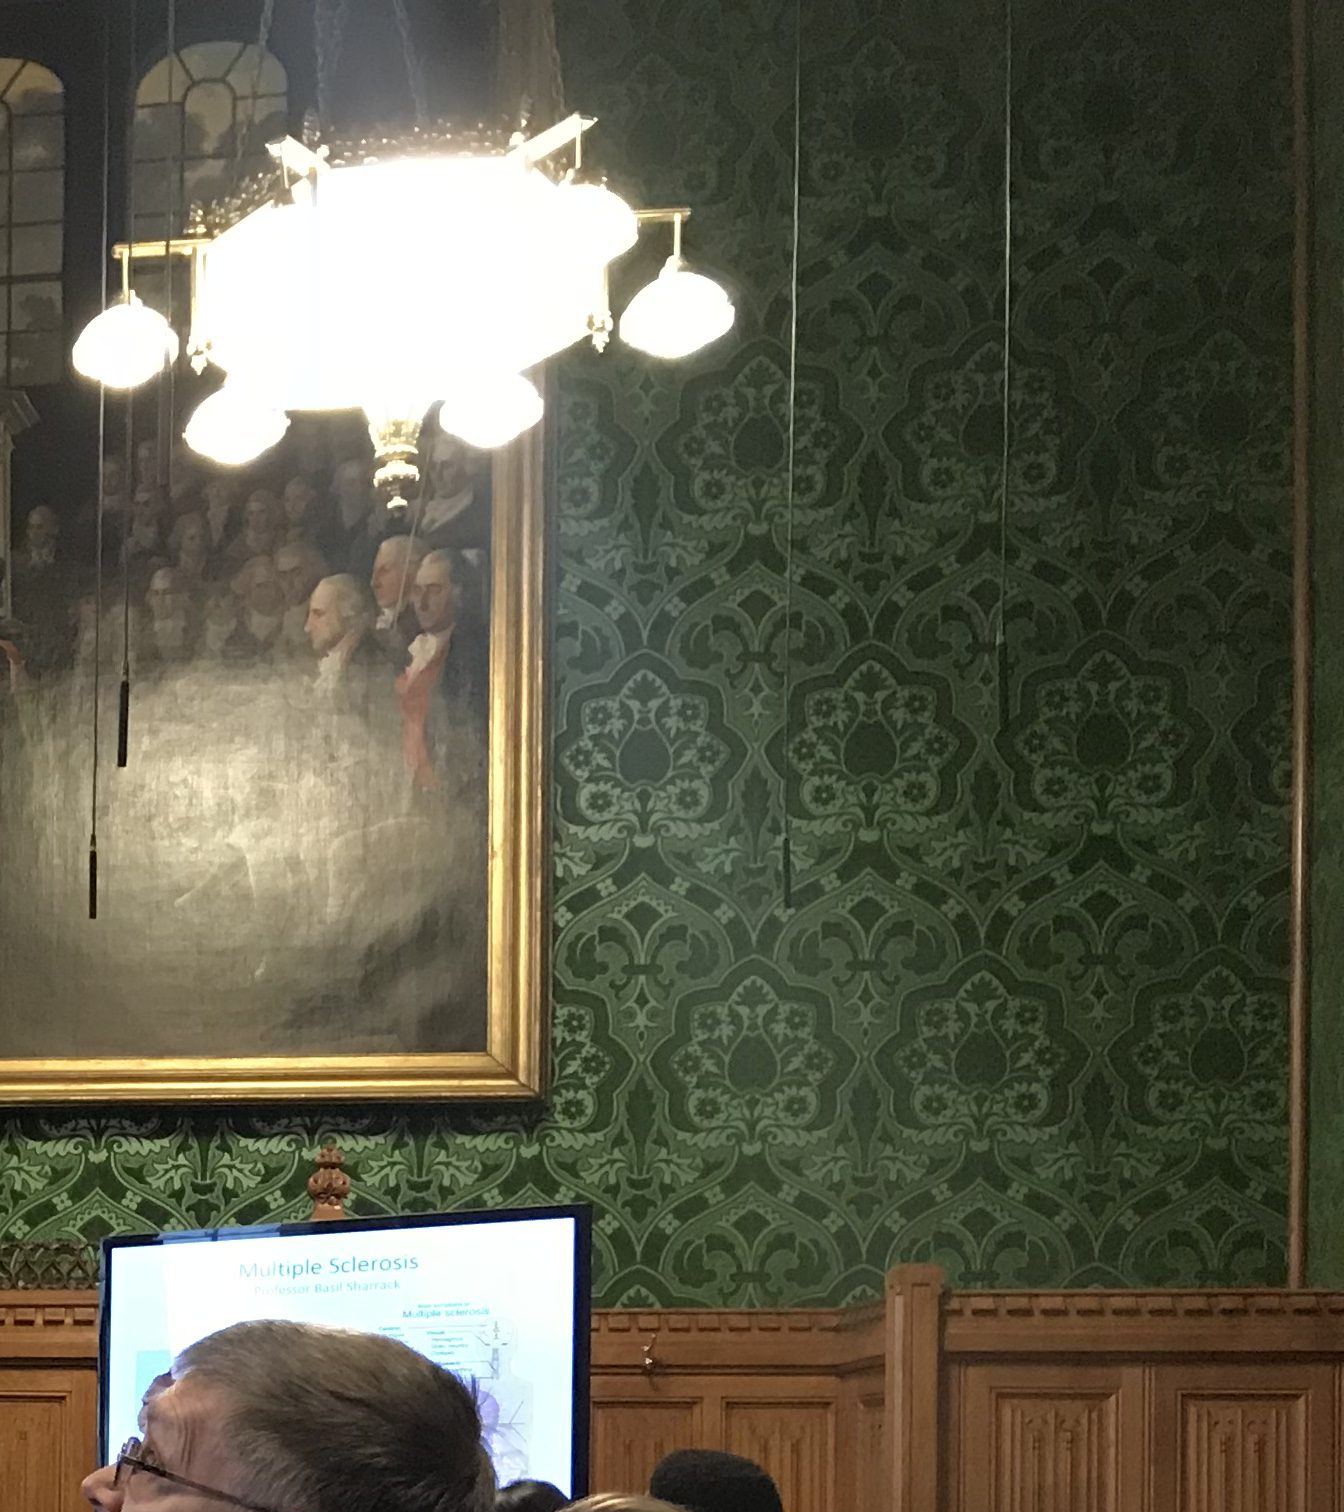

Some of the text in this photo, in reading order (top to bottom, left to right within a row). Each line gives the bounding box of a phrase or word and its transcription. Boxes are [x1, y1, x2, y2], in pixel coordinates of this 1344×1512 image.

[239, 1256, 419, 1279] Multiple Sclerosis
[314, 1282, 343, 1293] Basil
